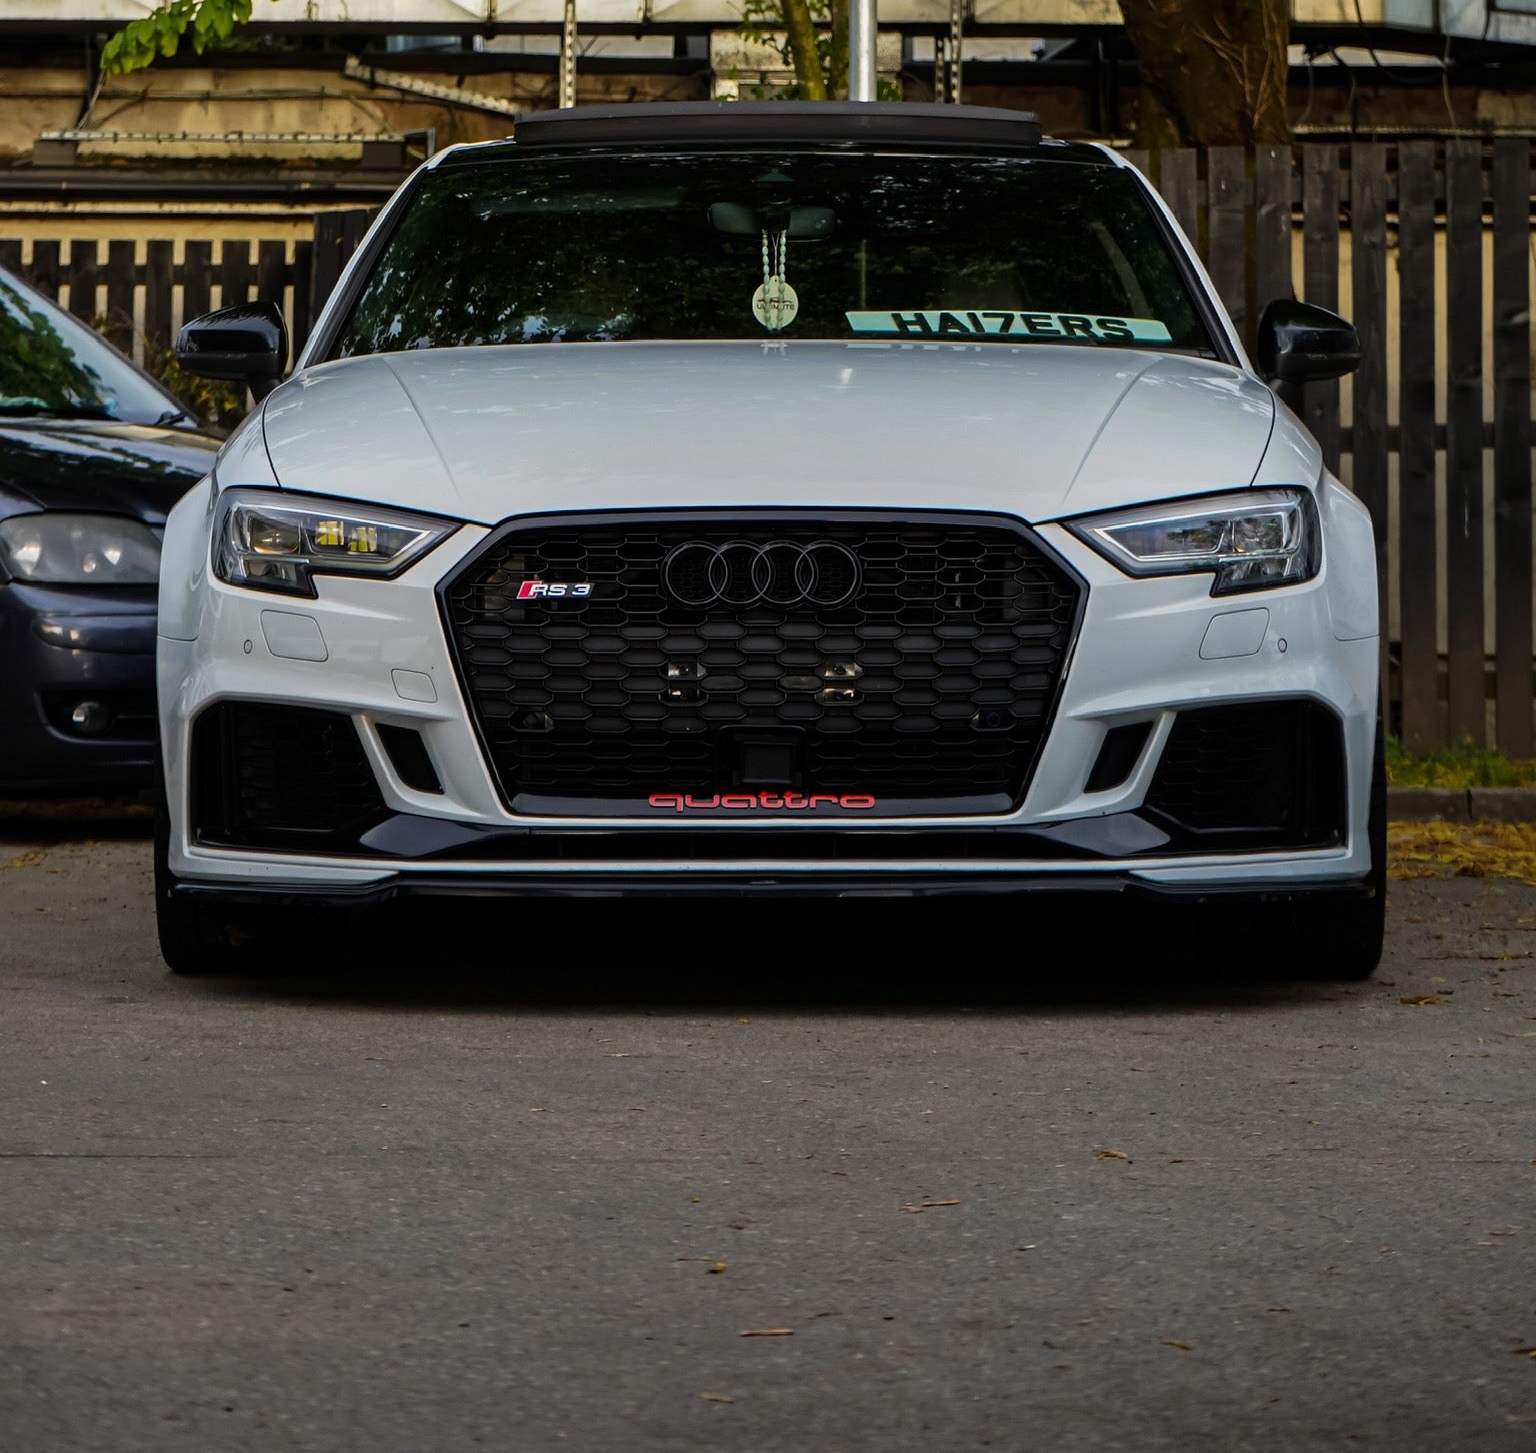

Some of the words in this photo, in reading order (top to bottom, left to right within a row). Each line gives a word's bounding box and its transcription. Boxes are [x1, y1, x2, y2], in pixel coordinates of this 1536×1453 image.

[528, 584, 567, 597] RS
[572, 584, 590, 596] 3
[649, 790, 875, 812] quattro
